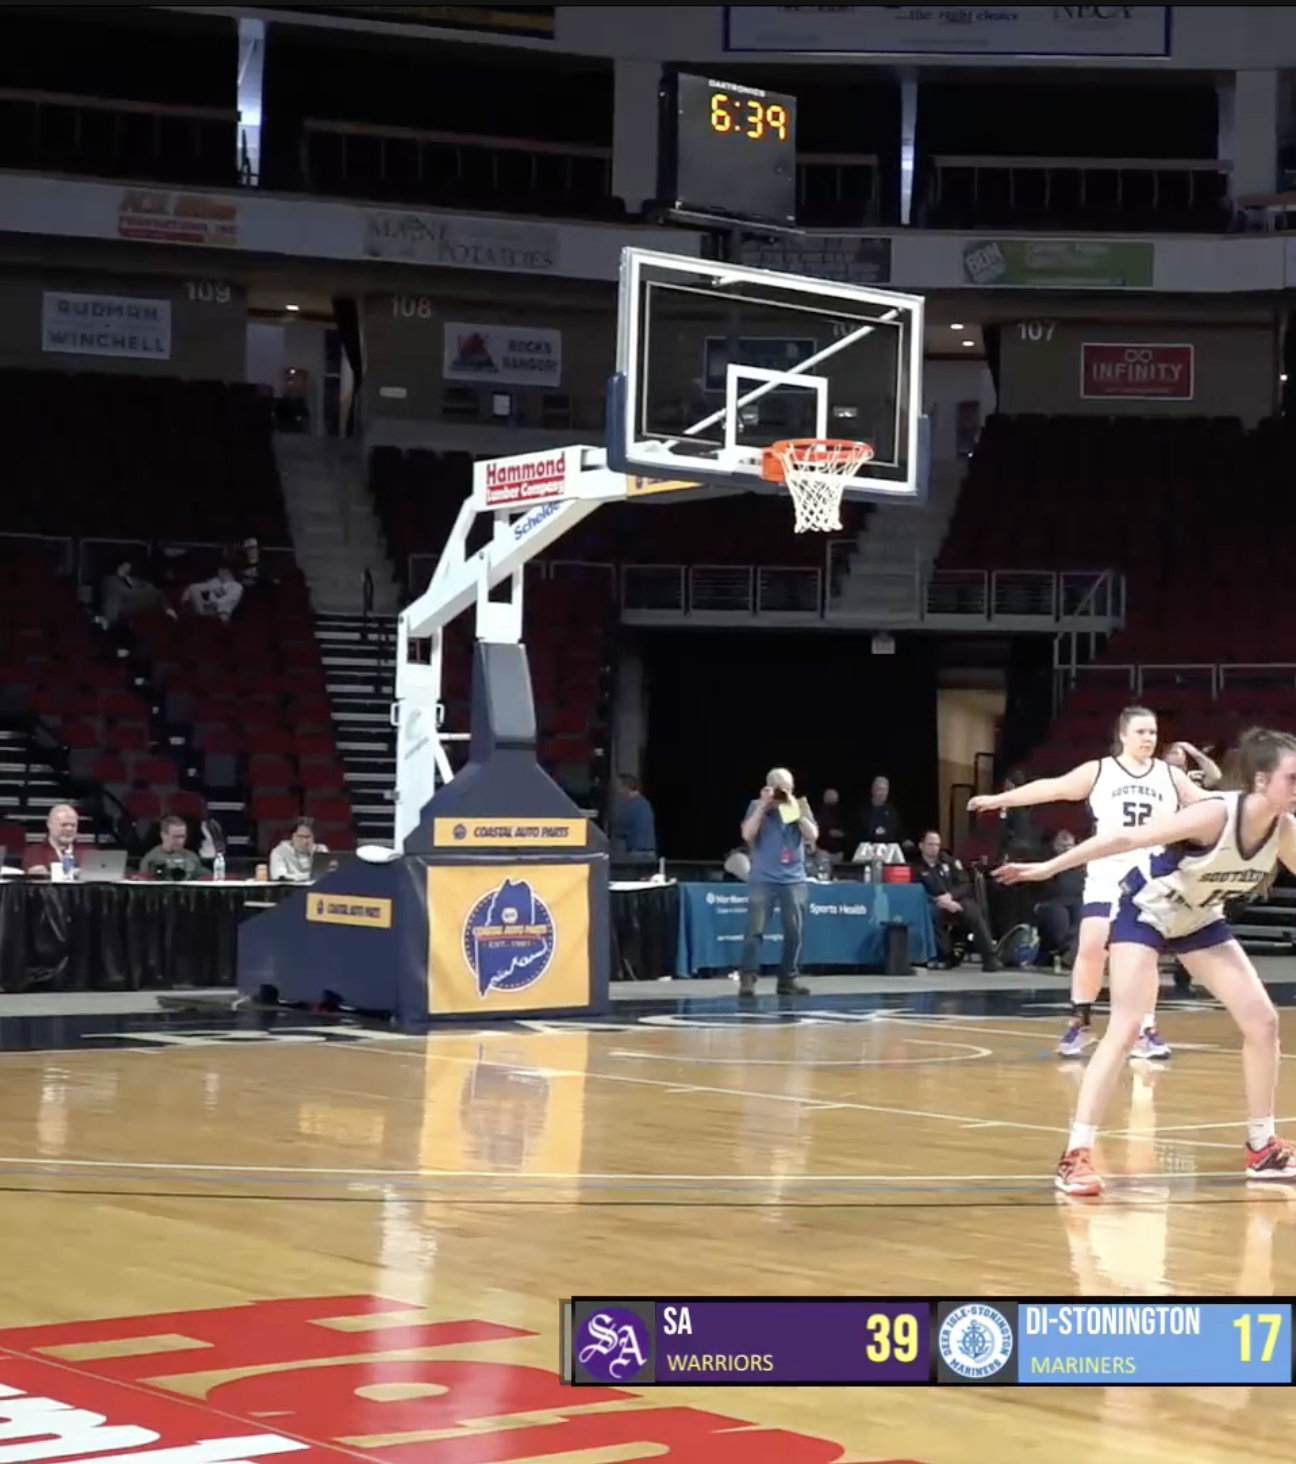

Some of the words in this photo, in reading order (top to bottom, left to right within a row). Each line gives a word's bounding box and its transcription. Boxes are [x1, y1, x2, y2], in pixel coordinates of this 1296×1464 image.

[976, 10, 1019, 22] choice
[711, 93, 786, 140] 6:39
[185, 280, 231, 303] 109
[57, 299, 159, 322] RUDMAN
[391, 295, 432, 319] 108
[48, 331, 166, 352] WINCHELL
[1017, 321, 1058, 341] 107
[1092, 363, 1184, 381] INFINITY
[486, 452, 566, 487] Hammond
[520, 479, 565, 498] Company
[513, 502, 561, 541] Schelde
[1122, 801, 1153, 828] 52
[473, 826, 513, 838] COASTAL
[514, 826, 540, 838] AUTO
[540, 826, 570, 838] PARTS
[809, 902, 838, 915] Sports
[839, 905, 867, 915] Health
